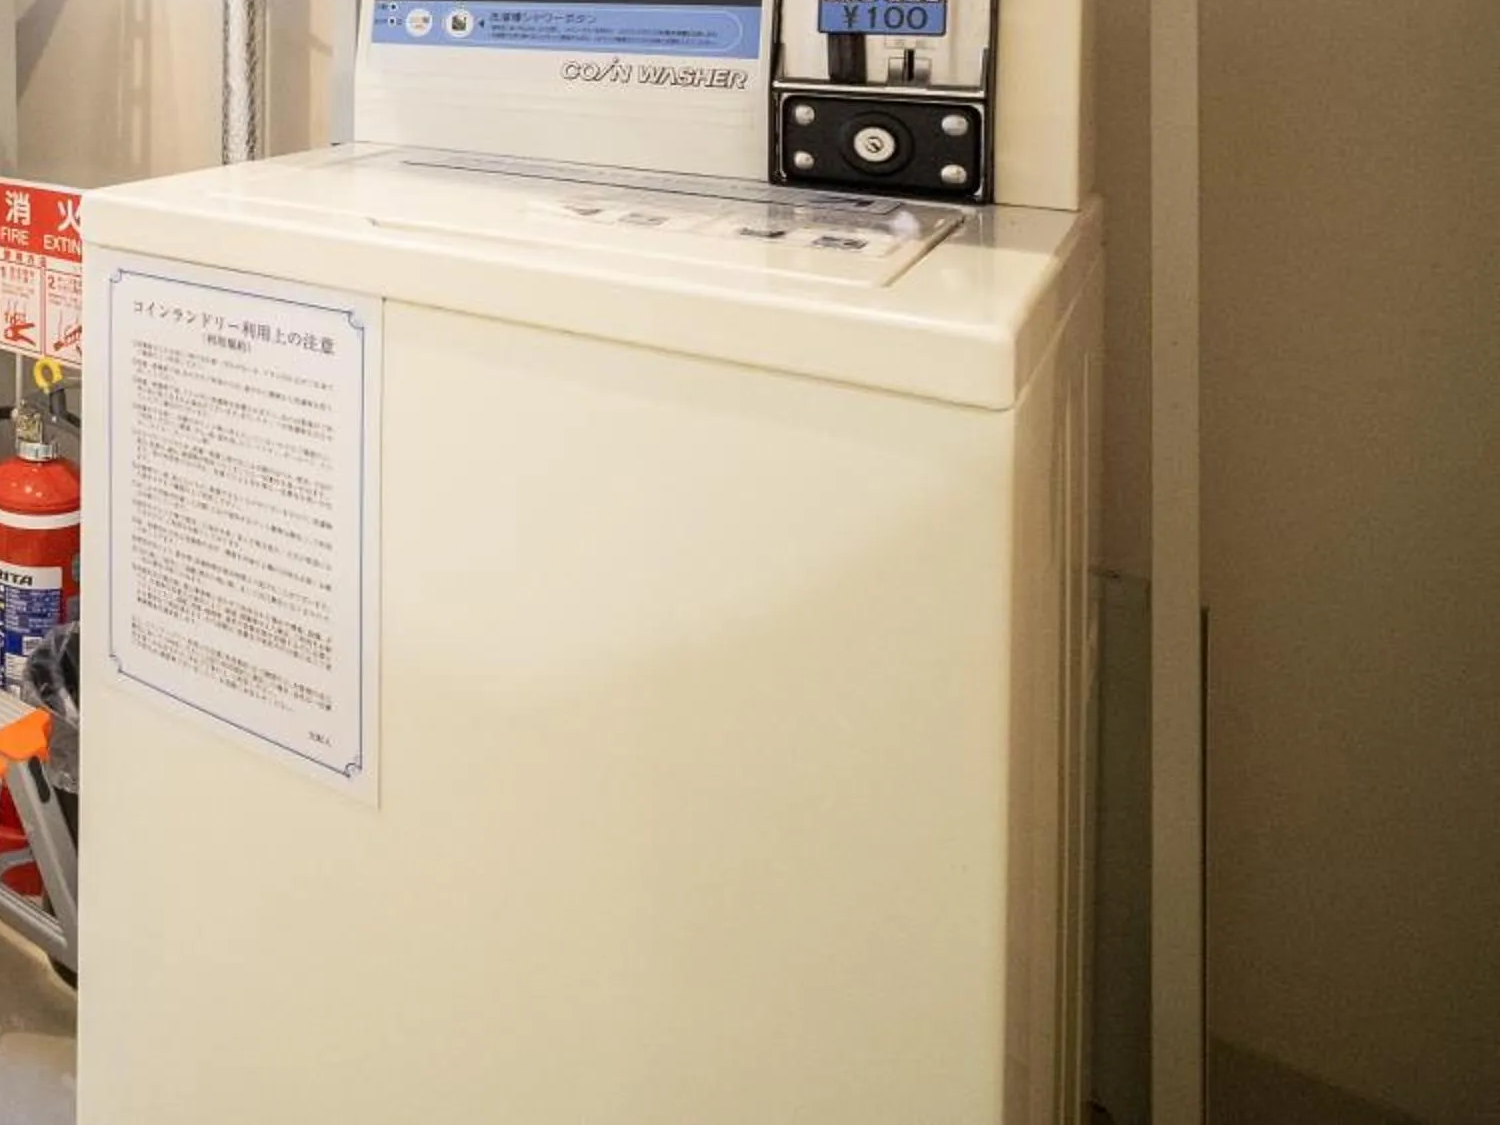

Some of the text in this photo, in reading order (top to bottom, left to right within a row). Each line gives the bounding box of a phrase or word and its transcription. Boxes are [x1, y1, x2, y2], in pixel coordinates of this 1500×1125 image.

[843, 5, 929, 30] ¥100
[561, 56, 749, 90] COIN WASHER
[1, 226, 30, 246] FIRE
[133, 300, 336, 355] コインランドリー利用上の注意
